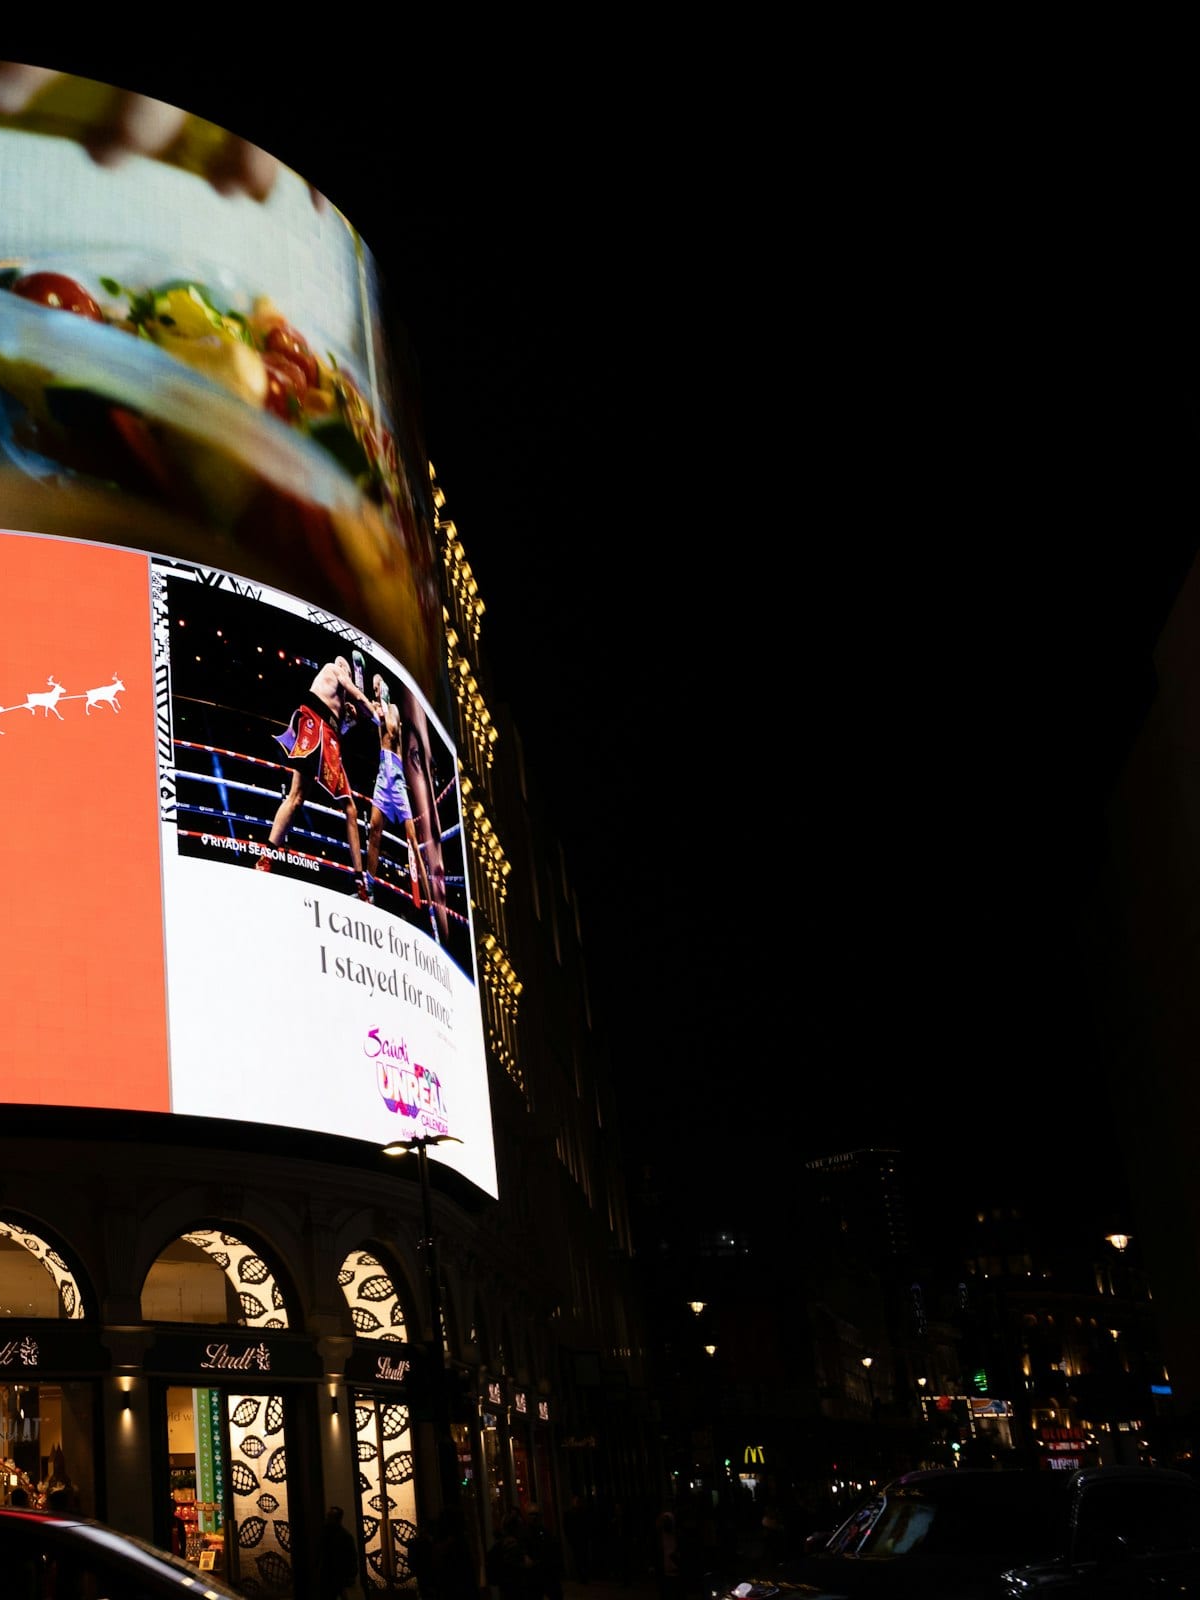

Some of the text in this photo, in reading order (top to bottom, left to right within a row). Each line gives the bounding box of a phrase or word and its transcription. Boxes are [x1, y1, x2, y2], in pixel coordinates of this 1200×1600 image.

[211, 836, 320, 872] RIYADH SEASON BOXING
[328, 911, 383, 949] came
[389, 925, 410, 961] for
[320, 945, 328, 974] I
[335, 956, 398, 997] stayed
[402, 974, 422, 1008] for
[364, 1025, 411, 1064] Saudi
[200, 1342, 256, 1371] Lindt
[375, 1356, 406, 1381] Lindt
